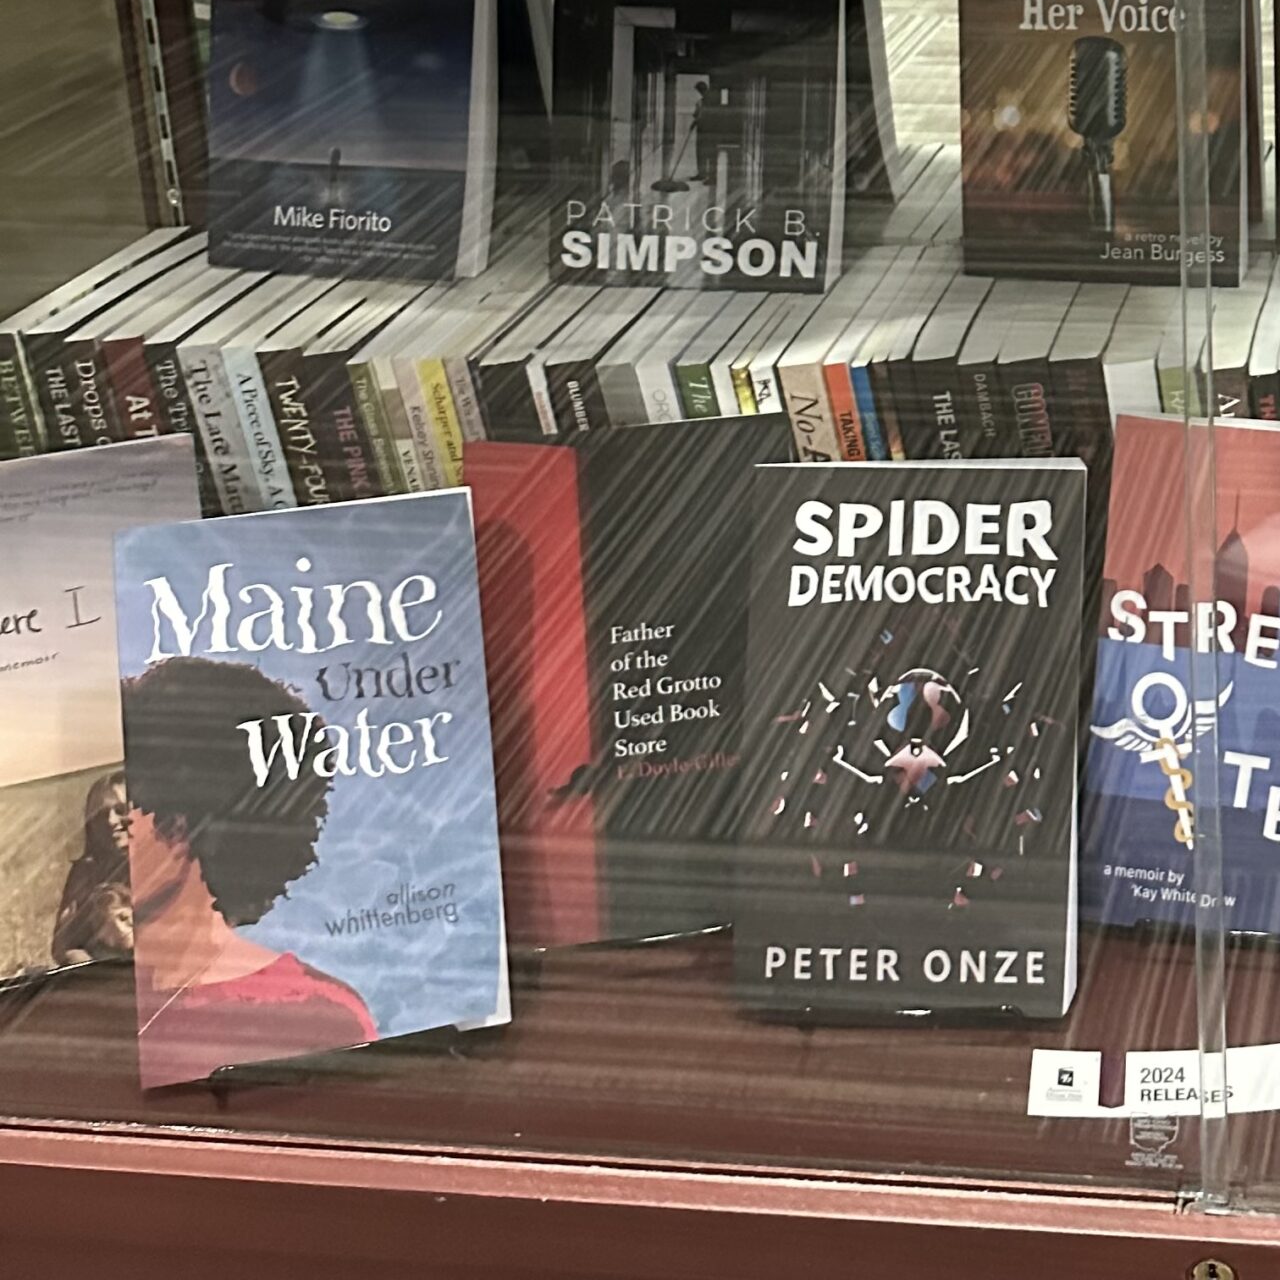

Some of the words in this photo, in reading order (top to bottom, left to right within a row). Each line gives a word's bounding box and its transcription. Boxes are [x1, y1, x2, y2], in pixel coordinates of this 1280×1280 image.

[273, 205, 324, 229] Mike
[328, 208, 393, 234] Fiorito
[566, 199, 758, 235] PATRICK
[784, 209, 822, 238] B.
[560, 230, 818, 279] SIMPSON
[1100, 243, 1145, 262] Jean
[973, 373, 997, 439] DAMBACH
[839, 409, 861, 458] TAKING
[791, 498, 1060, 562] SPIDER
[786, 564, 1058, 608] DEMOCRACY
[143, 556, 443, 665] Maine
[609, 622, 676, 645] Father
[610, 651, 632, 674] of
[635, 649, 670, 669] the
[611, 679, 653, 702] Red
[655, 672, 723, 697] Grotto
[612, 708, 665, 731] Used
[668, 699, 722, 723] Book
[235, 707, 453, 788] Water
[613, 736, 668, 758] Store
[1103, 864, 1113, 876] a
[1114, 864, 1165, 883] memoir
[1167, 868, 1186, 887] by
[385, 882, 457, 907] allison
[763, 945, 902, 982] PETER
[922, 948, 1047, 985] ONZE
[1139, 1066, 1187, 1085] 2024
